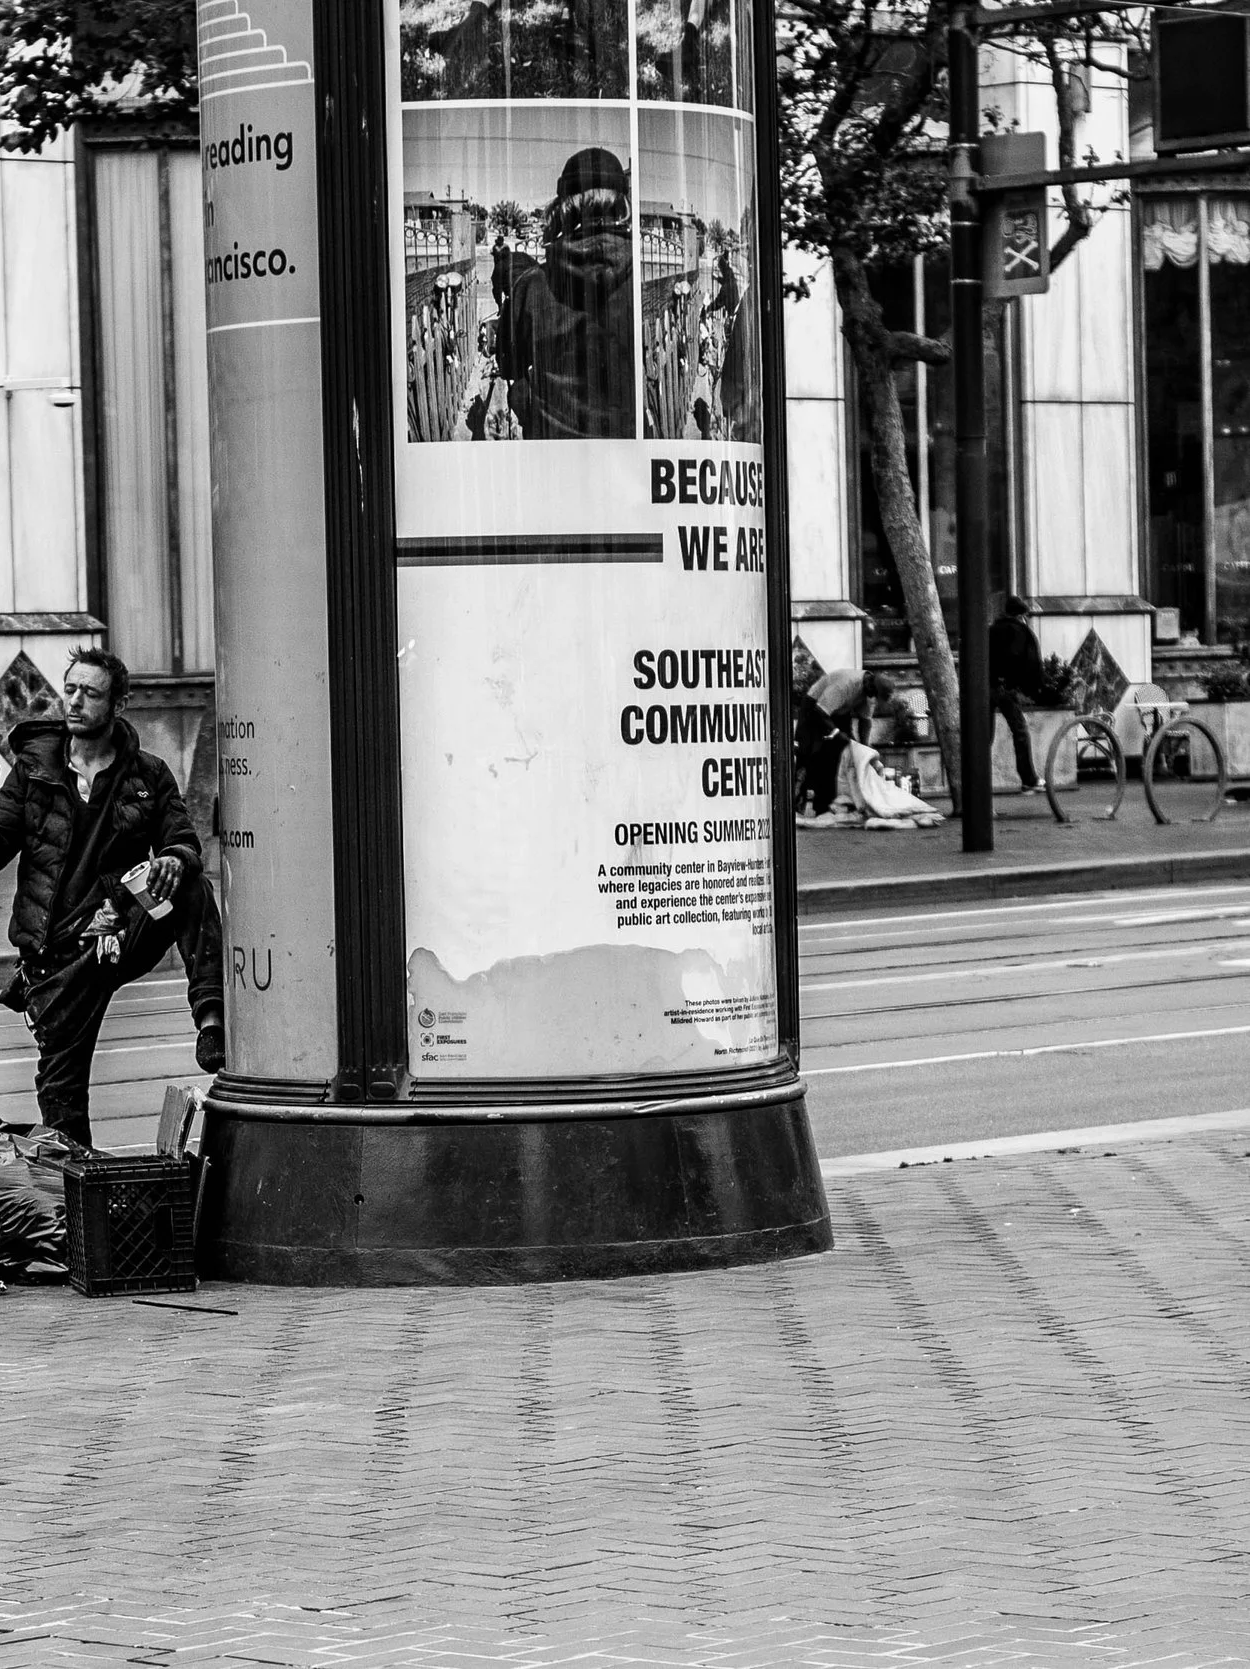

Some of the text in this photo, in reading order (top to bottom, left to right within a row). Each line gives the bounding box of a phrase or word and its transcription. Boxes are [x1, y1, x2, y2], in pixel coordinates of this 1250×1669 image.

[651, 459, 763, 507] BECAUSE
[678, 526, 764, 573] WE ARE
[633, 649, 766, 689] SOUTHEAST
[620, 703, 767, 745] COMMUNITY
[702, 757, 769, 798] CENTER
[614, 821, 698, 846] OPENING
[703, 819, 756, 843] SUMMER
[598, 864, 606, 877] A
[610, 862, 672, 878] community
[675, 861, 705, 874] center
[707, 860, 715, 873] in
[598, 880, 635, 893] where
[638, 879, 682, 895] legacies
[685, 878, 700, 890] are
[702, 876, 734, 889] honored
[736, 874, 747, 887] and
[616, 897, 637, 909] and
[641, 895, 697, 911] experience
[699, 893, 713, 906] the
[715, 891, 744, 905] center's
[617, 912, 653, 929] public
[655, 911, 671, 925] art
[673, 909, 720, 925] collection,
[722, 907, 751, 922] featuring
[664, 1008, 714, 1017] artist-in-residence
[715, 1006, 734, 1014] working
[685, 999, 701, 1007] These
[703, 998, 720, 1007] photos
[671, 1017, 693, 1025] Mildred
[721, 1015, 731, 1023] part
[421, 1052, 438, 1061] sfac
